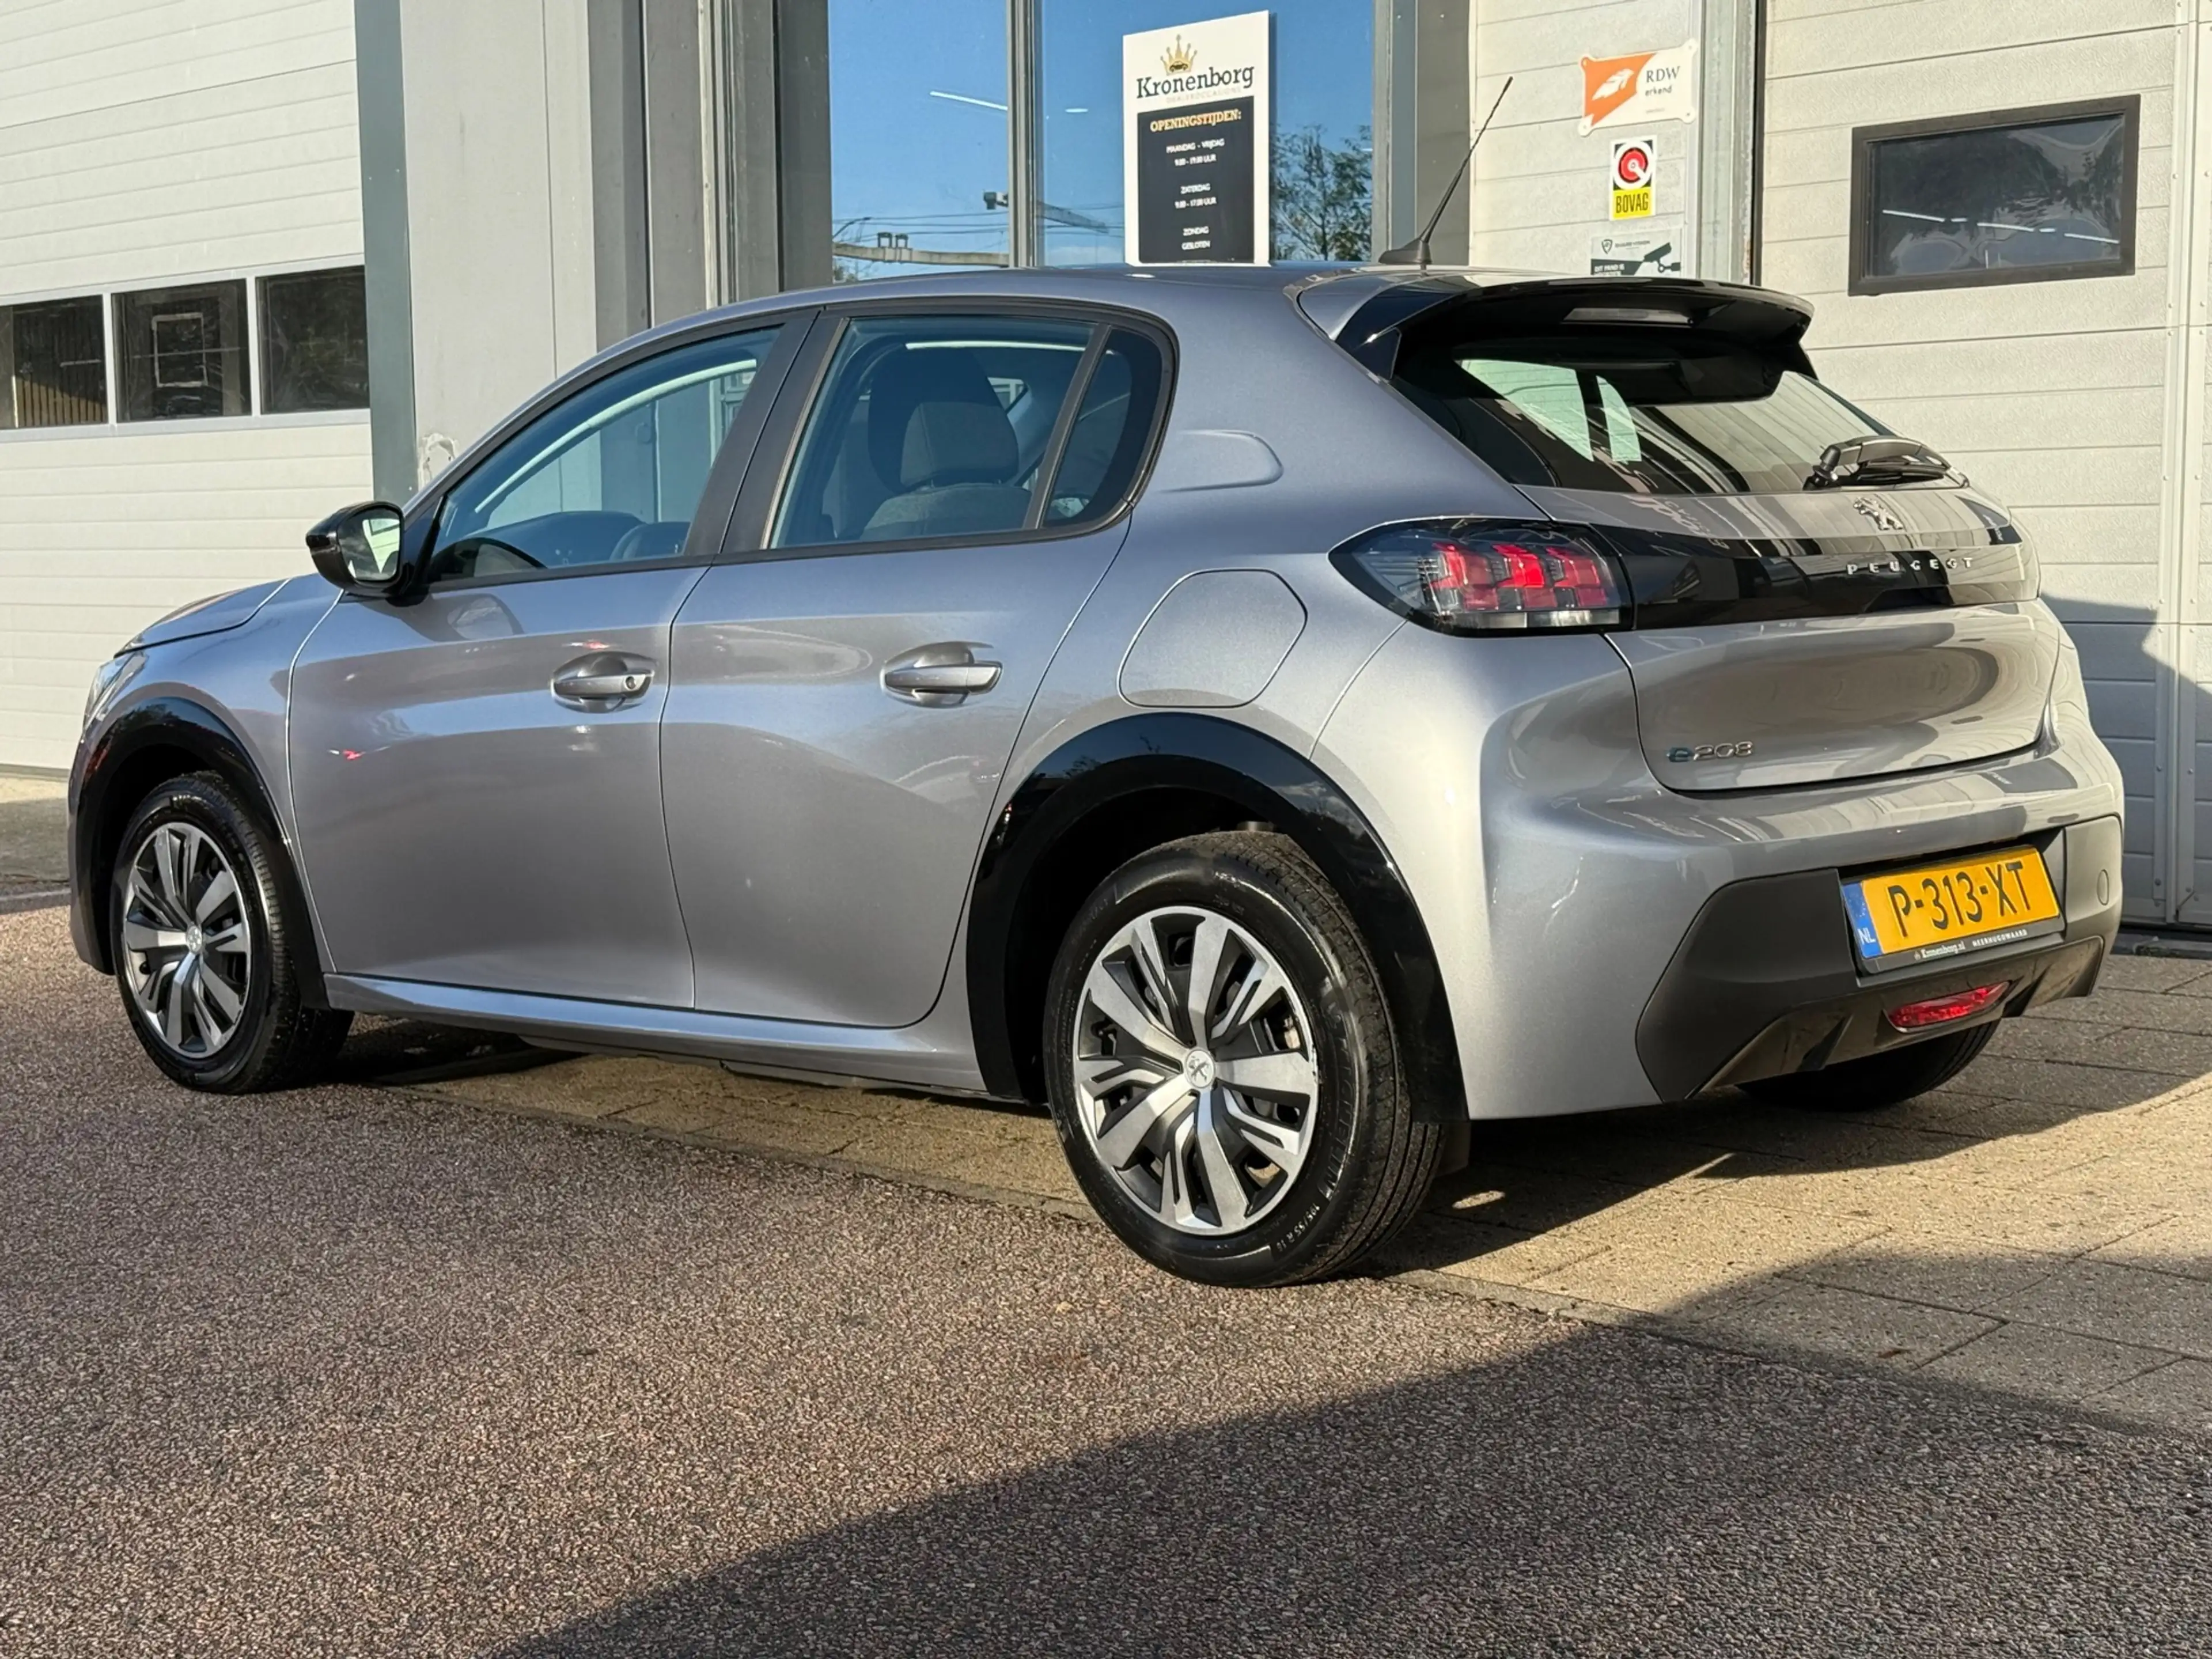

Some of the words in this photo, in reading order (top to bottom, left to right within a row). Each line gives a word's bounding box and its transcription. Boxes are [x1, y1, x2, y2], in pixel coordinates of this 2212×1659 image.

[1136, 66, 1255, 99] Kronenborg
[1646, 66, 1680, 83] RDW
[1645, 85, 1672, 97] erkend
[1149, 109, 1242, 132] OPENINGSTIJDEN:
[1615, 192, 1649, 213] BOVAG
[1183, 226, 1209, 236] ZONDAG
[1846, 556, 1974, 575] PEUGEOT
[1857, 927, 1876, 945] NL
[1887, 860, 2031, 938] P-313-XT
